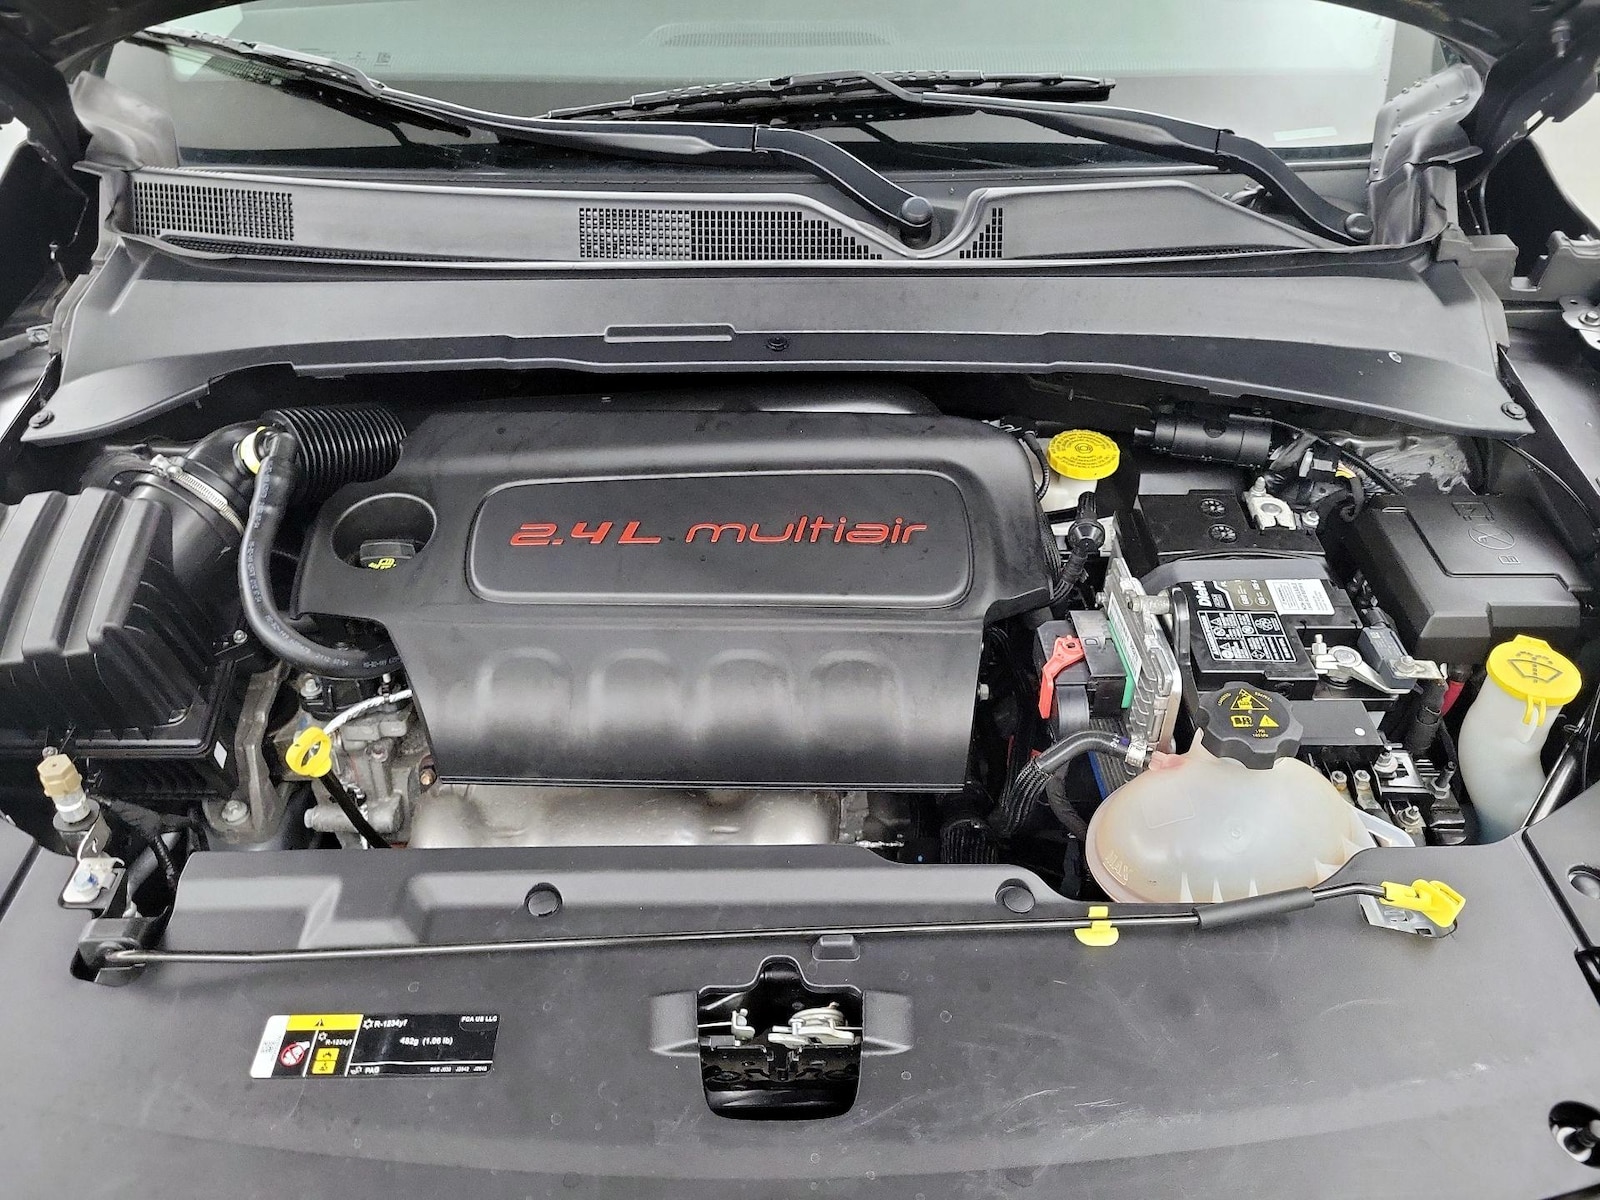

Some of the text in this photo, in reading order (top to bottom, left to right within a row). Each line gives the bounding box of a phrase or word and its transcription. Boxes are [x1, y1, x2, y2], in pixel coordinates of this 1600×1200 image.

[685, 516, 928, 544] multiair
[1191, 580, 1213, 607] DieH
[373, 1018, 408, 1029] R-1234yf
[485, 1015, 498, 1023] LLC
[325, 1038, 352, 1047] R-1234yf
[400, 1037, 419, 1047] 482g
[442, 1036, 453, 1046] lb)
